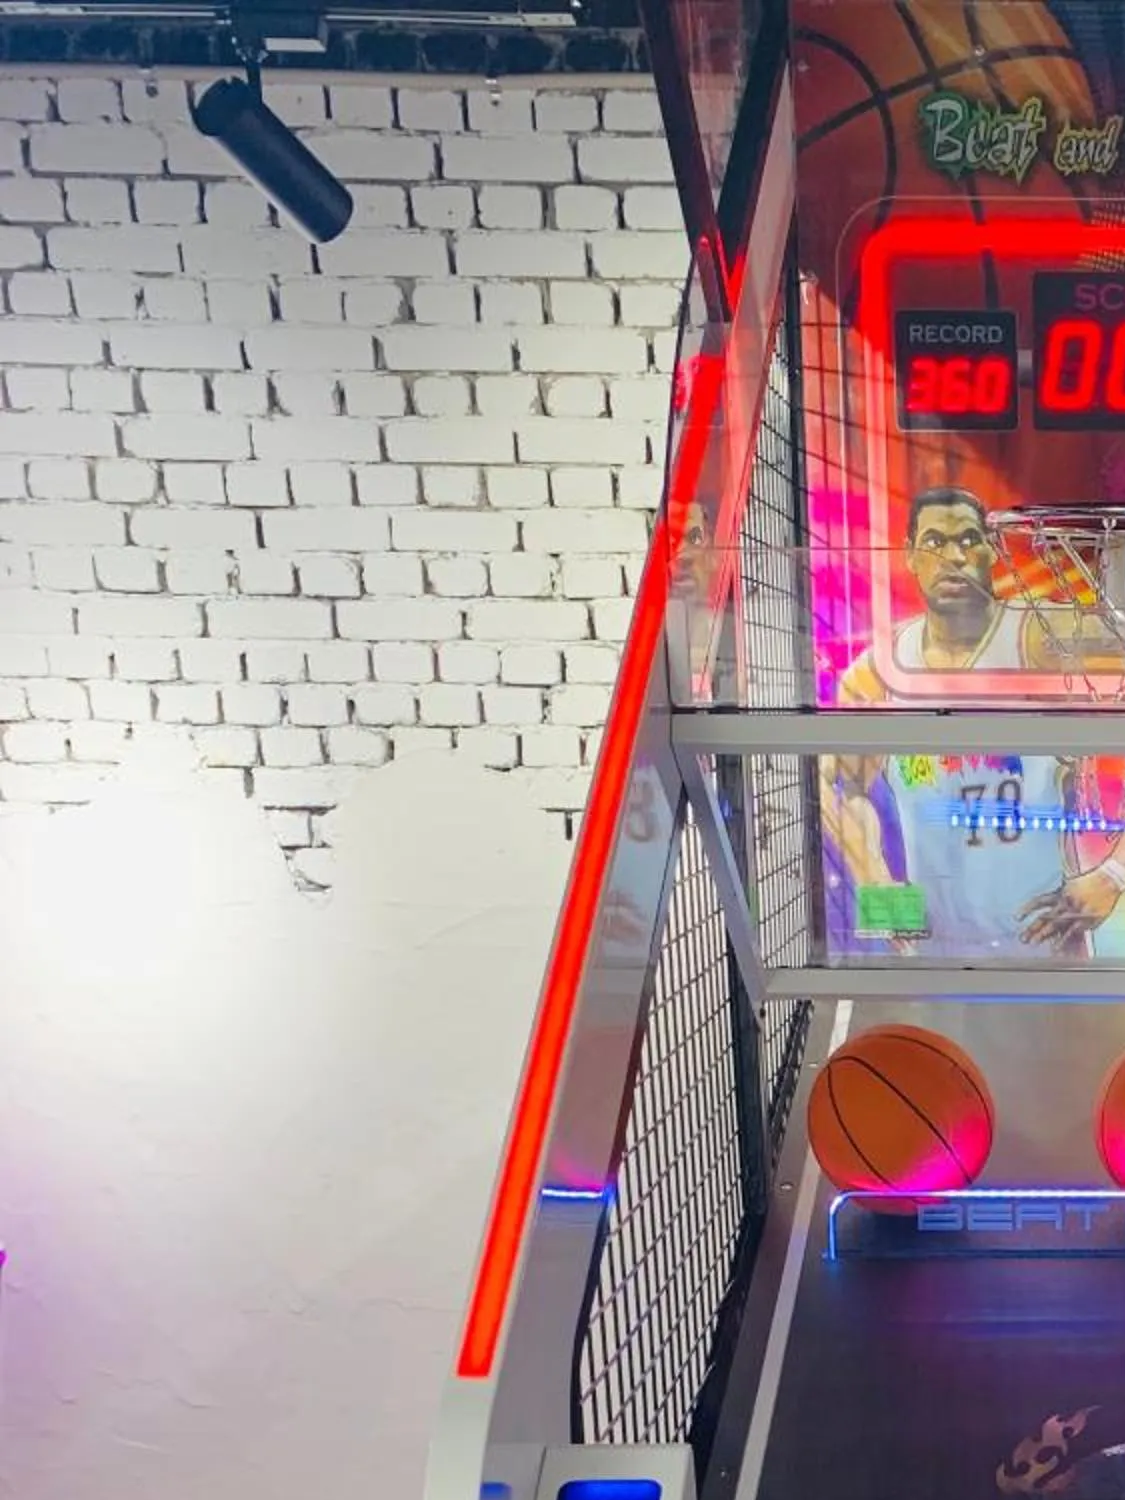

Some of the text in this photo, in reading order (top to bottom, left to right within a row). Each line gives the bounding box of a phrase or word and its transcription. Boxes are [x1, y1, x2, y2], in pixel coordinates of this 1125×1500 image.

[921, 95, 1046, 180] Beat
[1054, 116, 1118, 173] and
[909, 323, 1002, 345] RECORD
[905, 356, 1012, 413] 360
[917, 1203, 1107, 1231] BEAT
